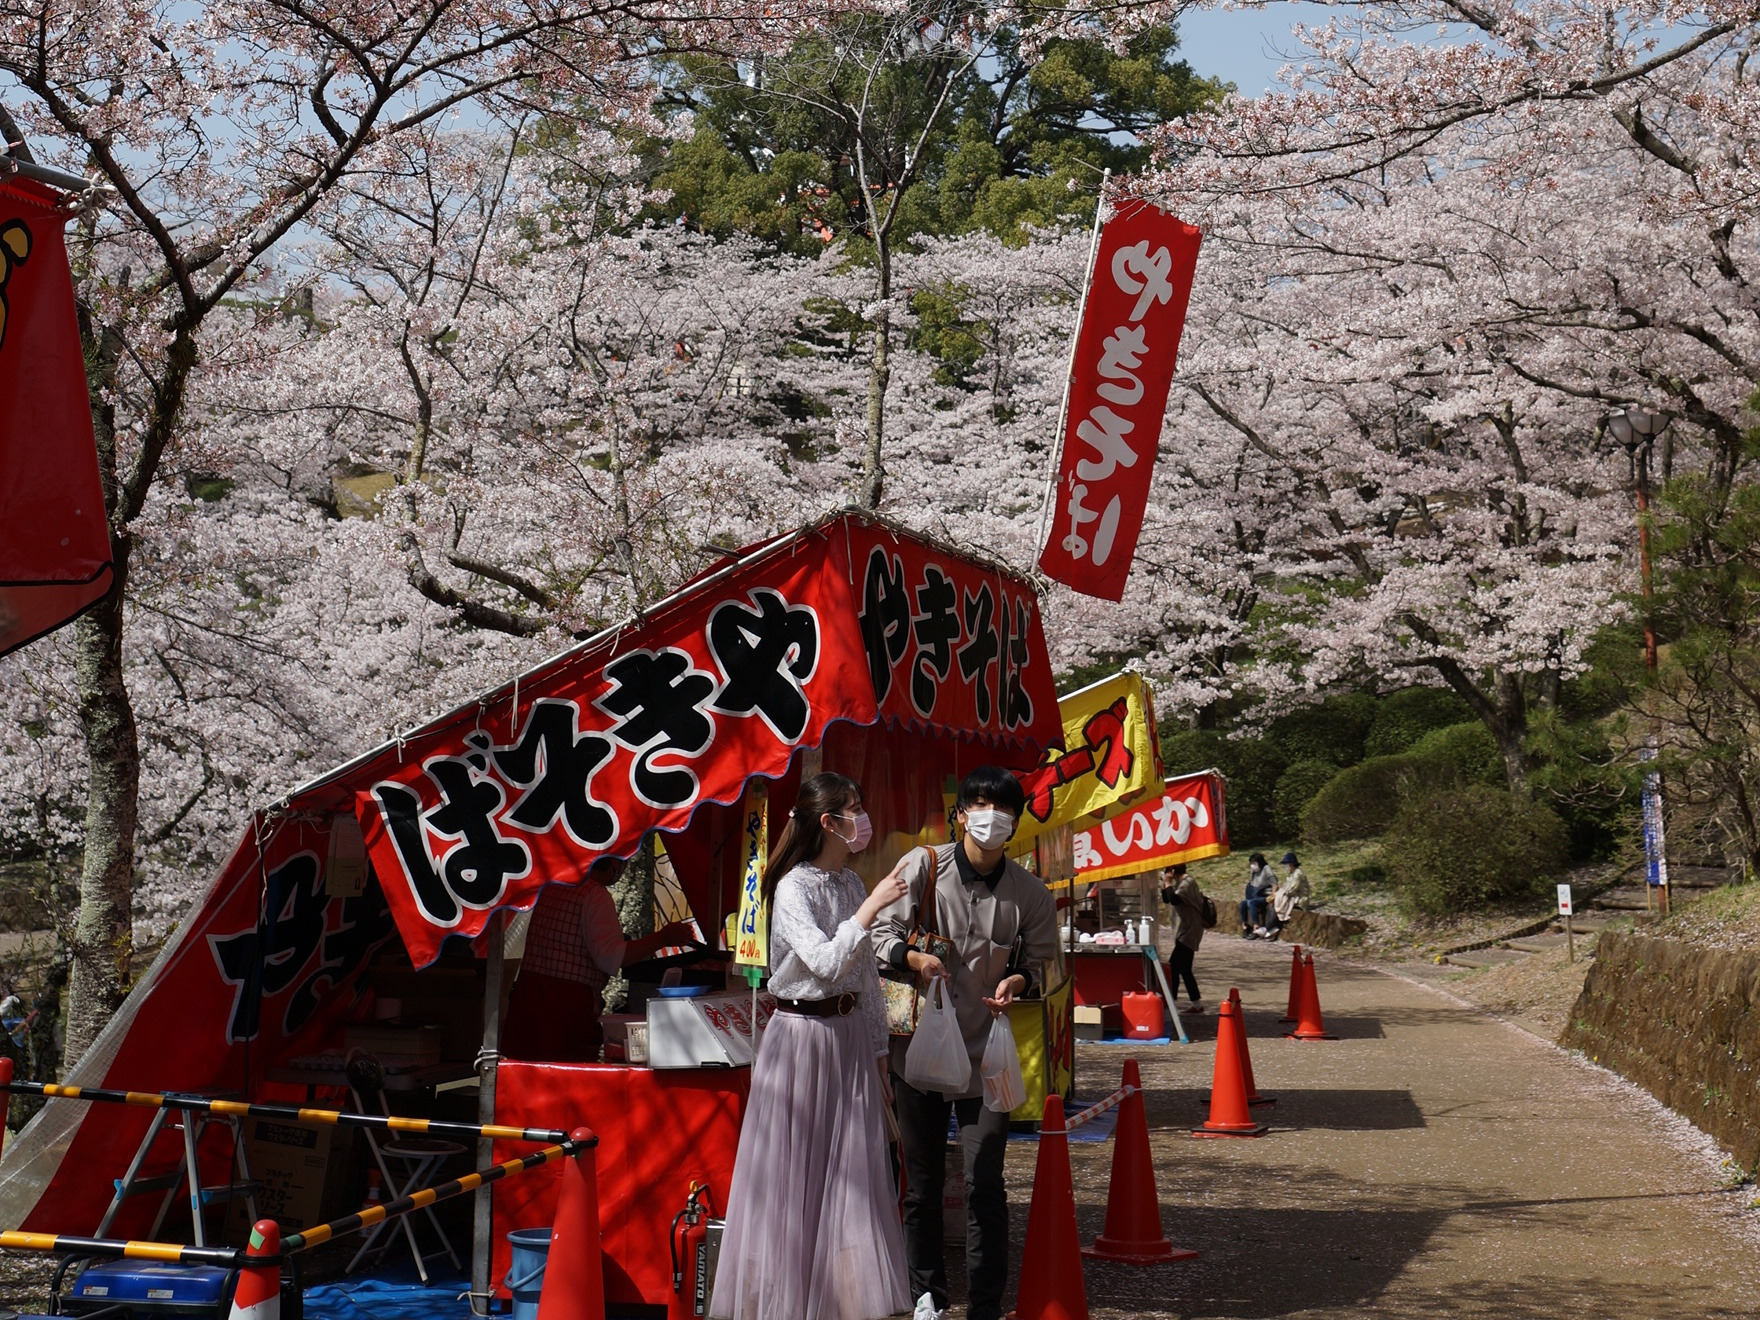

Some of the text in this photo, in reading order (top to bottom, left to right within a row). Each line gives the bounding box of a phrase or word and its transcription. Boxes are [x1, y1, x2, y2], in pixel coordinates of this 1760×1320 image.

[858, 544, 1034, 731] やきそば
[742, 810, 761, 935] やきそば
